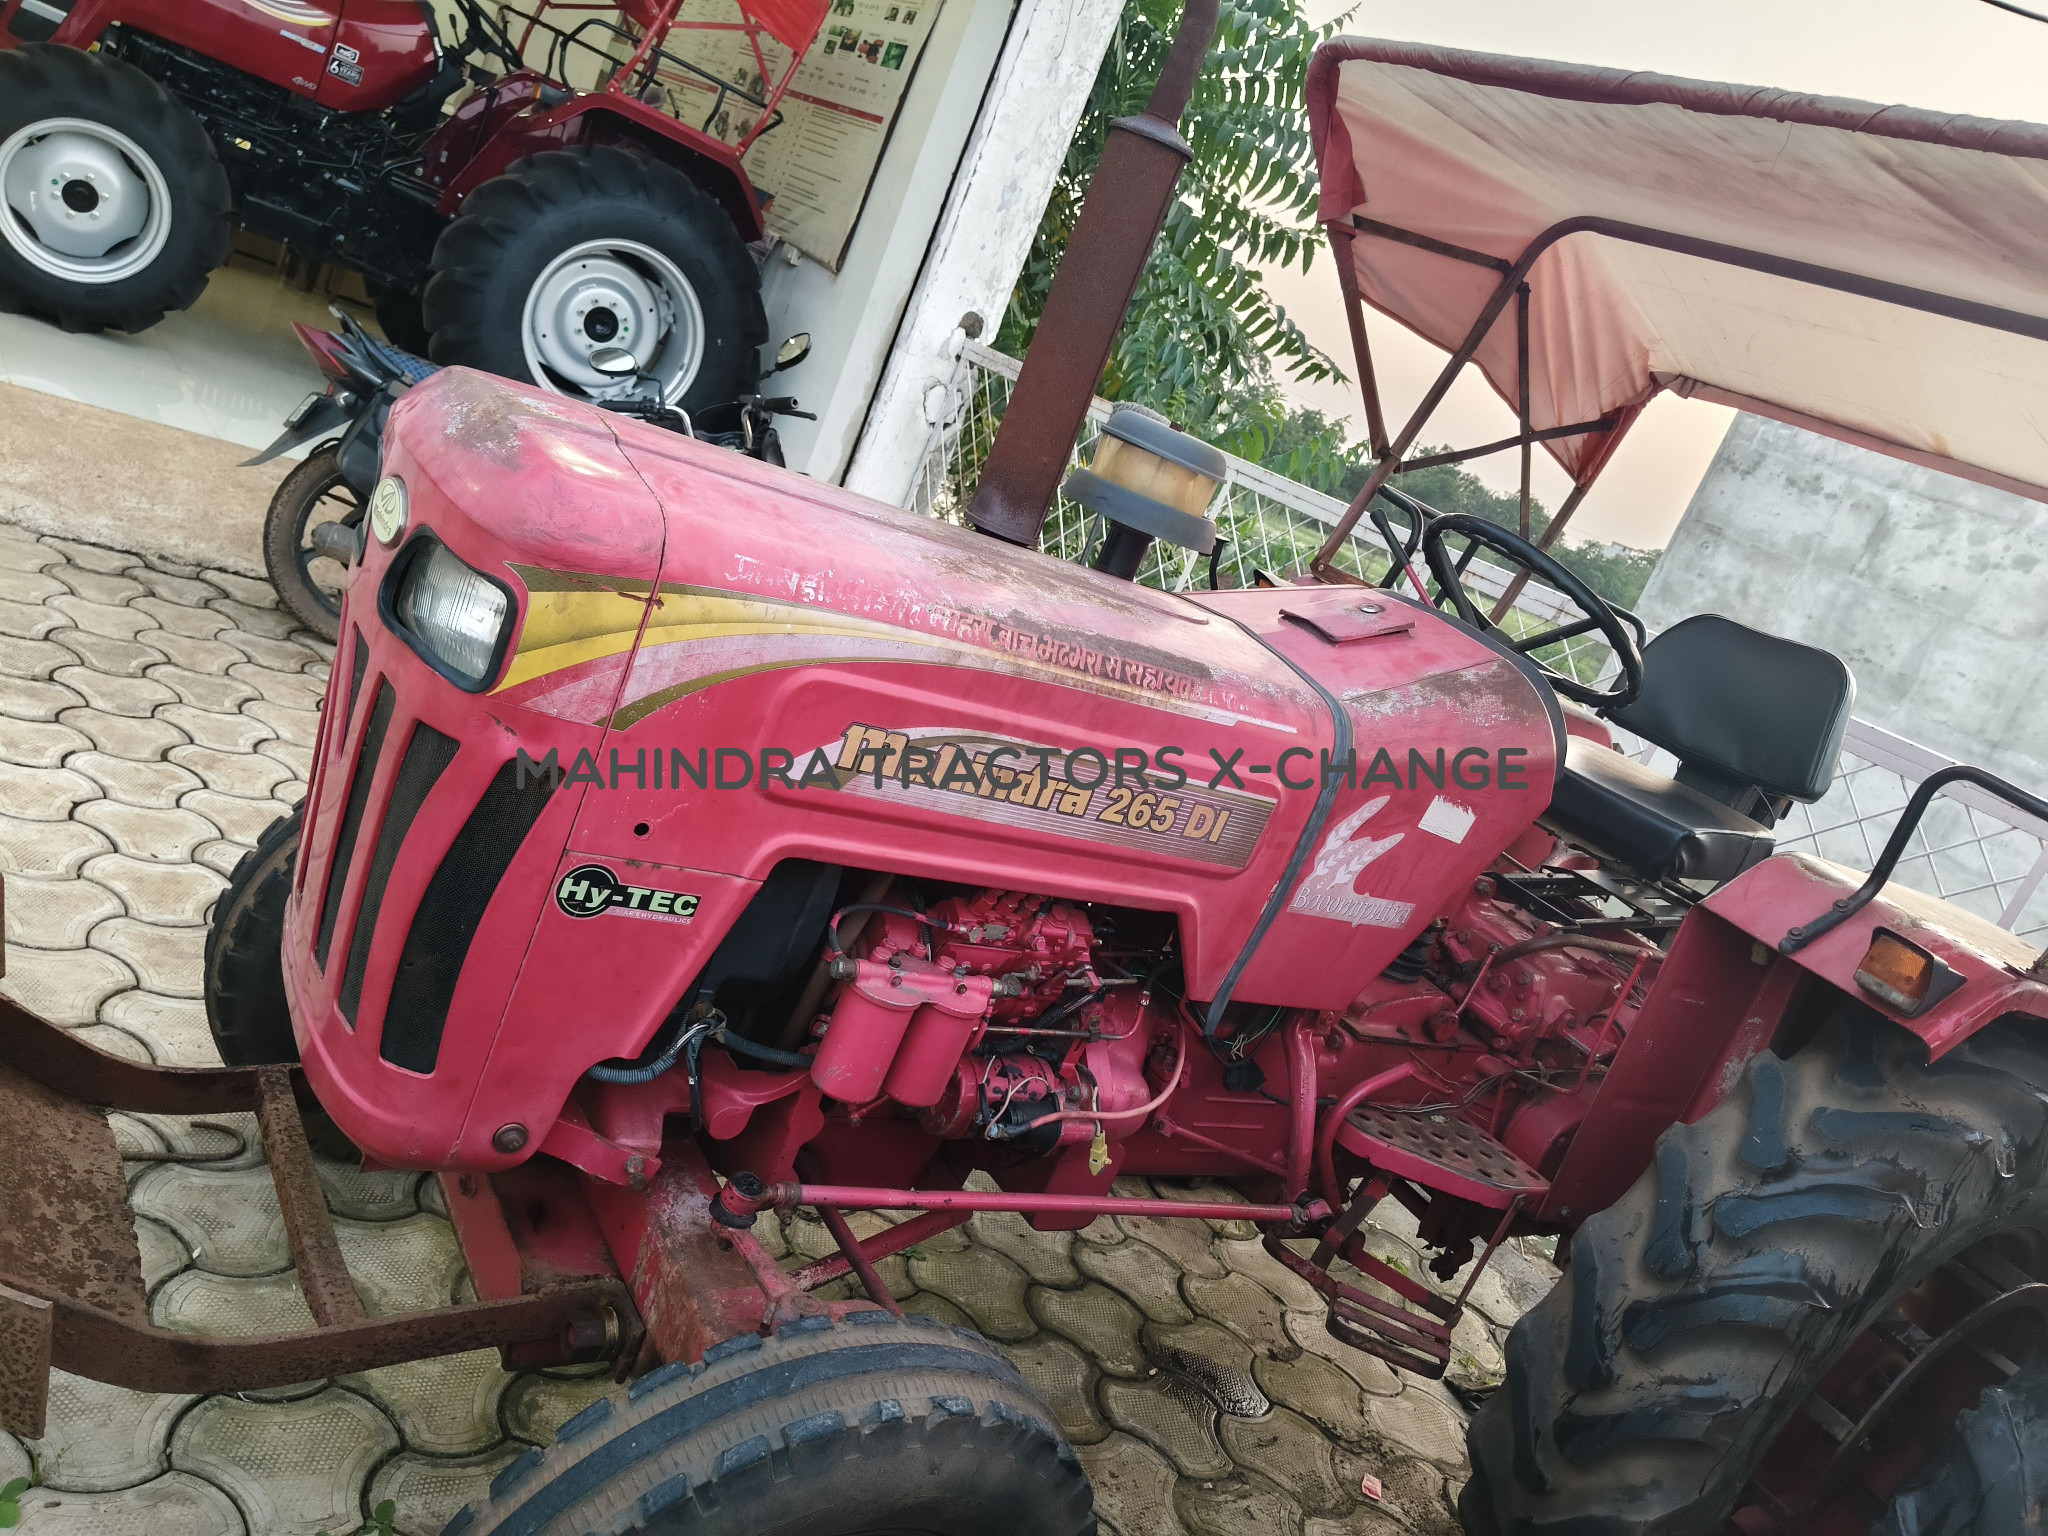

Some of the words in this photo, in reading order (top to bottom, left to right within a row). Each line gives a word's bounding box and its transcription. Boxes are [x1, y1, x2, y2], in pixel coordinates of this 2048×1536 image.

[330, 60, 340, 74] 6
[1096, 785, 1184, 833] 265
[1180, 803, 1232, 846] DI
[558, 877, 698, 917] Hy-TEC
[641, 911, 692, 925] HYDRAULICS
